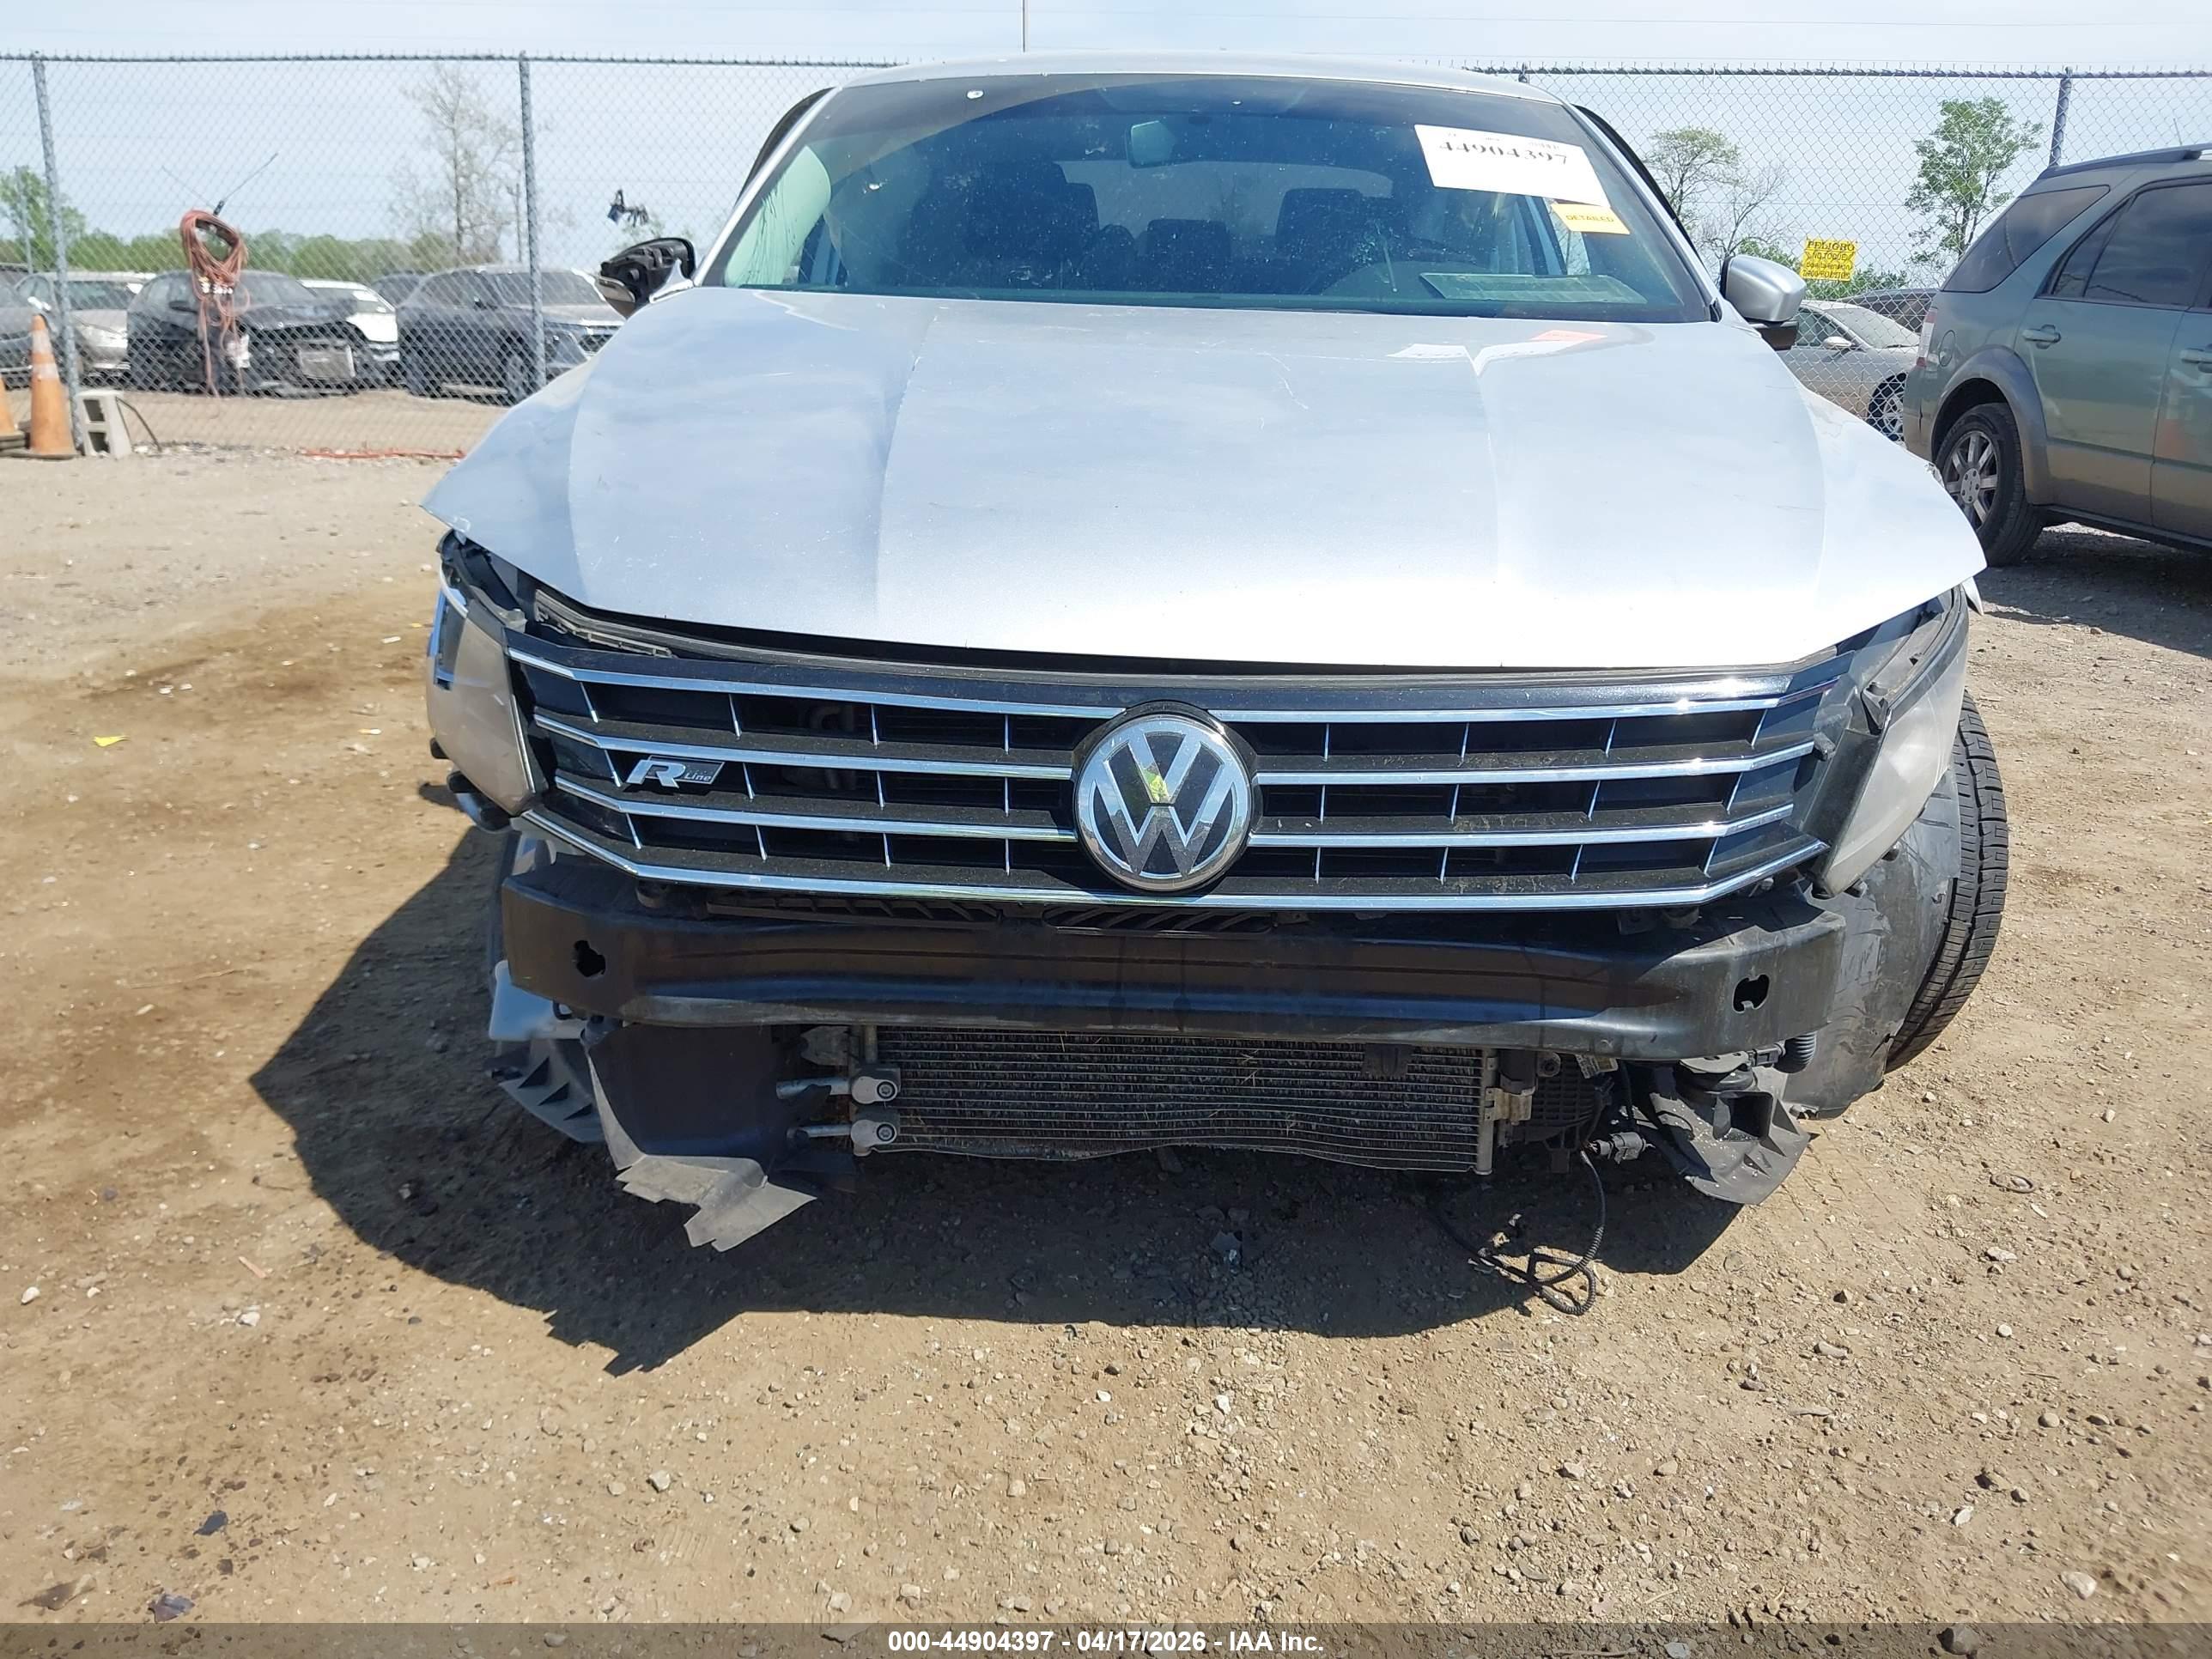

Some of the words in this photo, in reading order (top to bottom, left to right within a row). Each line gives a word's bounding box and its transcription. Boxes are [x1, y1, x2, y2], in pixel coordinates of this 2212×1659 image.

[1439, 142, 1567, 165] 44904397
[1808, 241, 1855, 252] PELIGRO
[1813, 252, 1821, 260] NO
[626, 759, 686, 788] R
